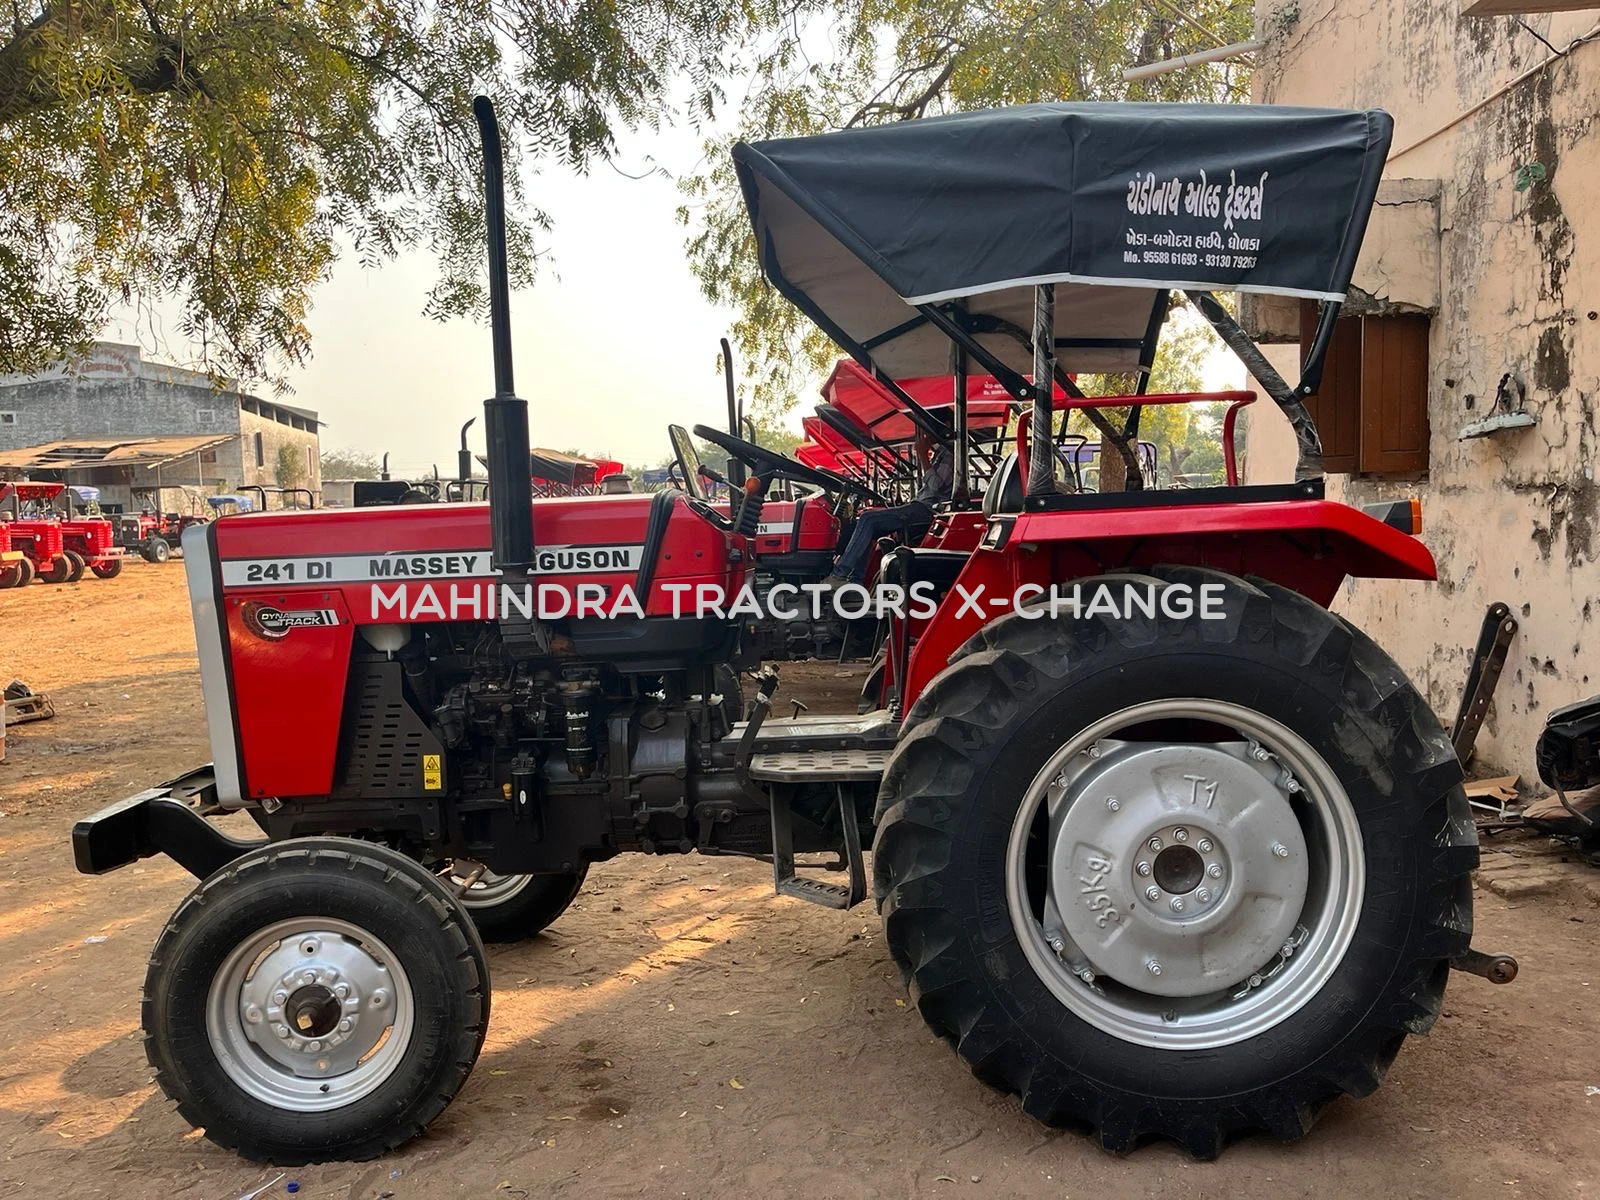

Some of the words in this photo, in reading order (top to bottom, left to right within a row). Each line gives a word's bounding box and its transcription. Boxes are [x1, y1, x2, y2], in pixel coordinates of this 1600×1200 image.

[1123, 250, 1141, 263] Mo.
[1143, 251, 1170, 265] 95588
[1171, 253, 1198, 266] 61693
[1205, 254, 1231, 268] 93130
[246, 562, 297, 582] 241
[306, 560, 333, 580] DI
[368, 555, 478, 577] MASSEY
[490, 550, 630, 573] GUSON
[261, 612, 290, 620] DYNA
[277, 616, 321, 627] TRACK
[1183, 774, 1220, 810] T1
[1080, 857, 1121, 929] 35Kg
